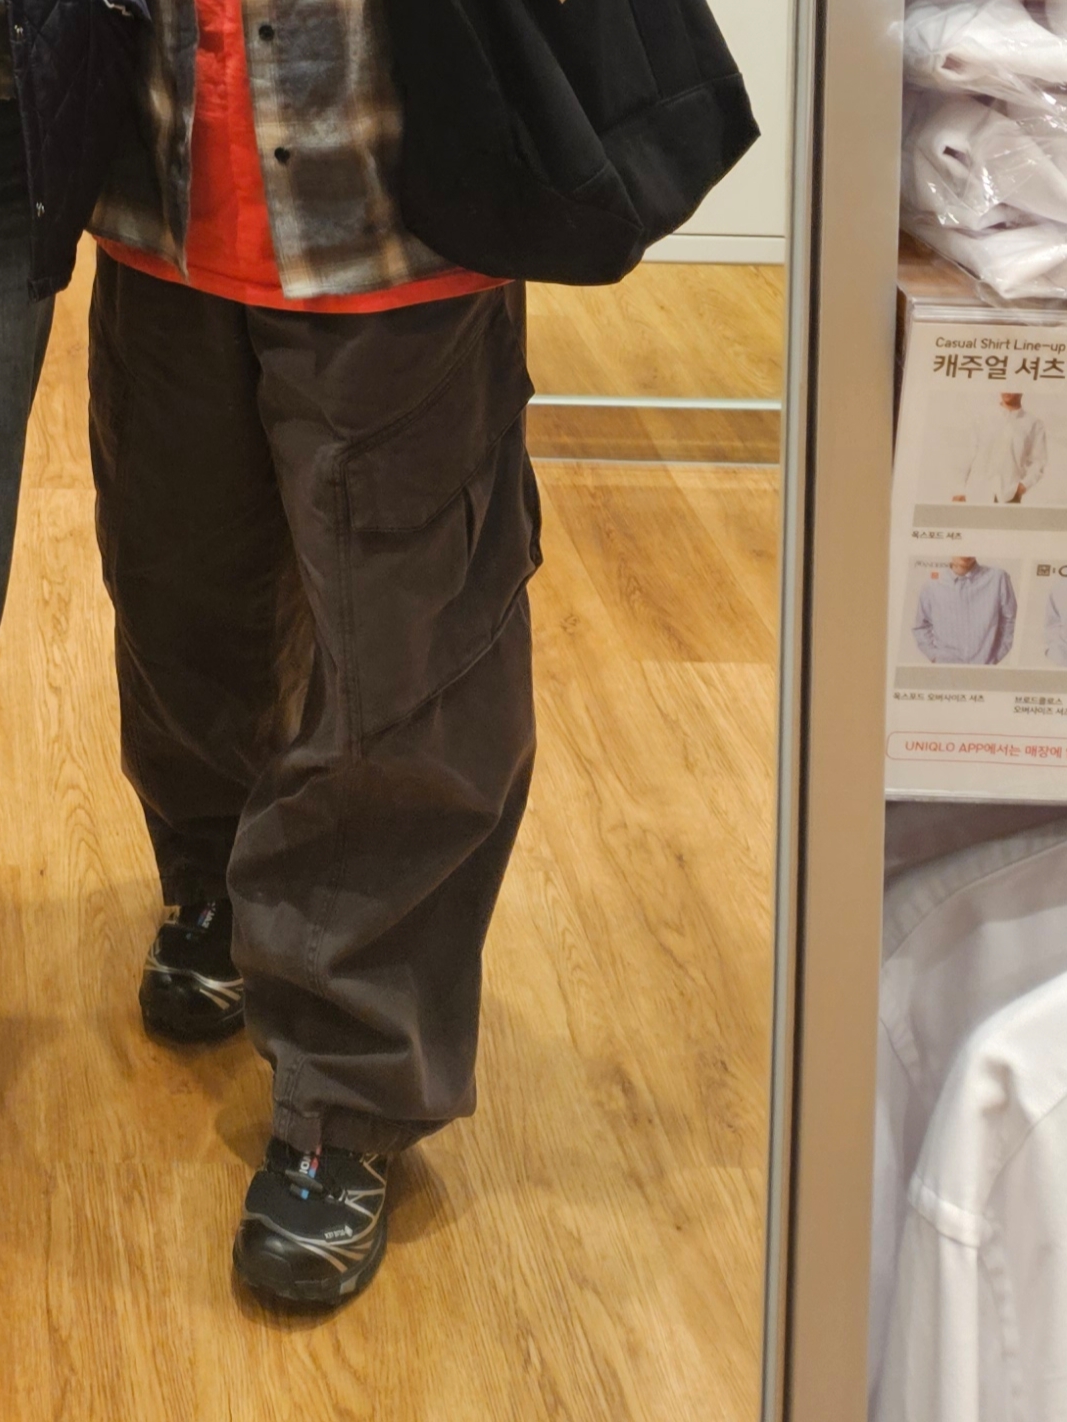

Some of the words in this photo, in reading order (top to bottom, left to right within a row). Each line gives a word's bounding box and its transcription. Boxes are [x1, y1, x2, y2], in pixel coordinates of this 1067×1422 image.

[935, 336, 977, 349] Casual
[980, 338, 1011, 350] Shirt
[1013, 339, 1066, 355] Line-up
[933, 353, 1009, 381] 캐주얼
[1014, 356, 1066, 381] 셔츠
[905, 740, 956, 753] UNIQLO
[958, 742, 1021, 757] APP에서는
[1024, 745, 1063, 759] 매장에
